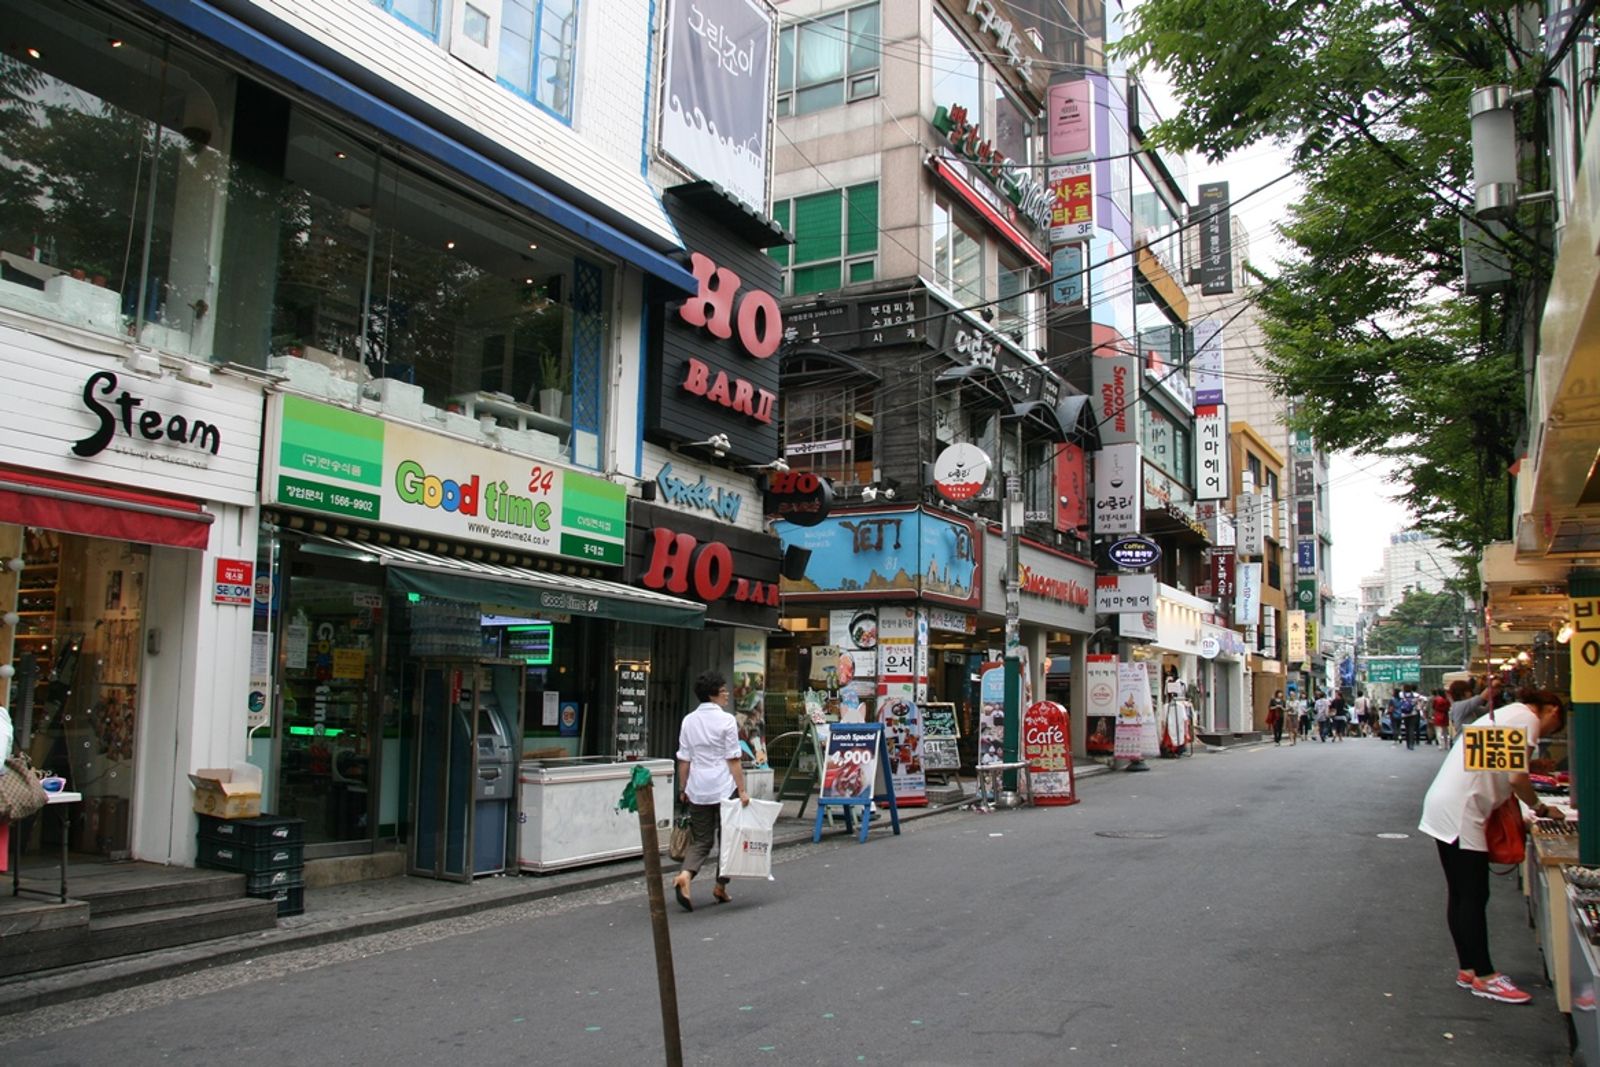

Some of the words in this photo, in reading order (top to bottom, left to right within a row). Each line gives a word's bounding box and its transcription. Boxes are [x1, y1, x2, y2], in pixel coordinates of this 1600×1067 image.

[1056, 182, 1090, 202] 사주
[1053, 206, 1091, 224] 타로
[1078, 224, 1092, 234] 3F
[680, 252, 783, 358] HO
[1102, 383, 1114, 418] KING
[1113, 366, 1127, 433] SMOOTHIE
[71, 371, 220, 457] Steam
[1203, 423, 1220, 492] 세마헤어
[528, 466, 553, 495] 24
[770, 471, 819, 495] HO
[330, 494, 373, 512] 1566-9902
[395, 460, 479, 517] Good
[485, 480, 551, 531] time
[643, 528, 733, 602] HO
[734, 578, 779, 607] BAR
[217, 585, 250, 597] SECOM
[1099, 595, 1150, 608] 세마헤어
[886, 657, 914, 674] 은서
[832, 732, 851, 742] Lunch
[851, 732, 876, 744] Special
[1026, 726, 1064, 744] Café
[831, 750, 872, 766] 4,900
[1466, 729, 1525, 770] 귀뚫음
